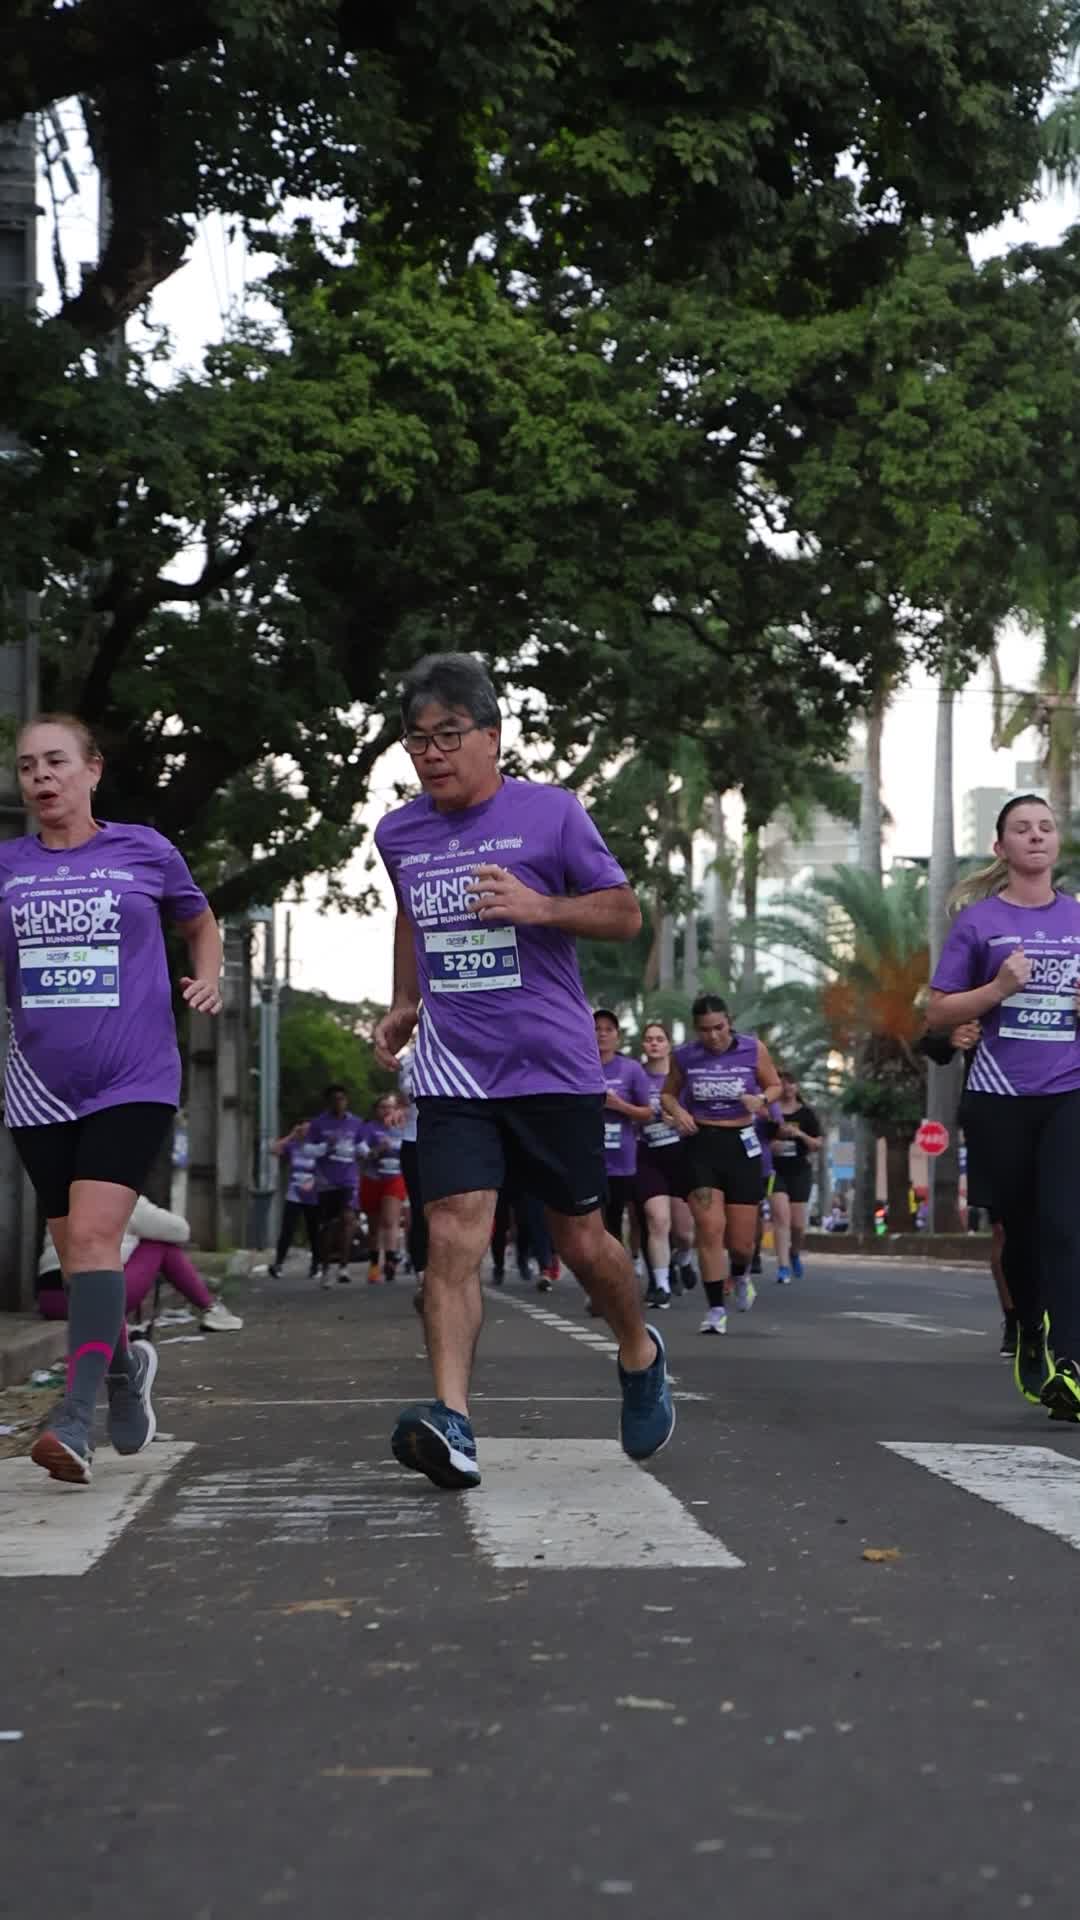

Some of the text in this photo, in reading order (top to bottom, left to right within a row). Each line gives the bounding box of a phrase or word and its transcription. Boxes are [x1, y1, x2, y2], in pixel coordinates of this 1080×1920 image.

[410, 876, 480, 901] MUND
[11, 897, 103, 920] MUNDO
[440, 912, 477, 924] RUNNING
[443, 952, 496, 971] 5290
[1031, 958, 1075, 972] NDO
[40, 968, 97, 987] 6509
[1017, 1009, 1062, 1025] 6402
